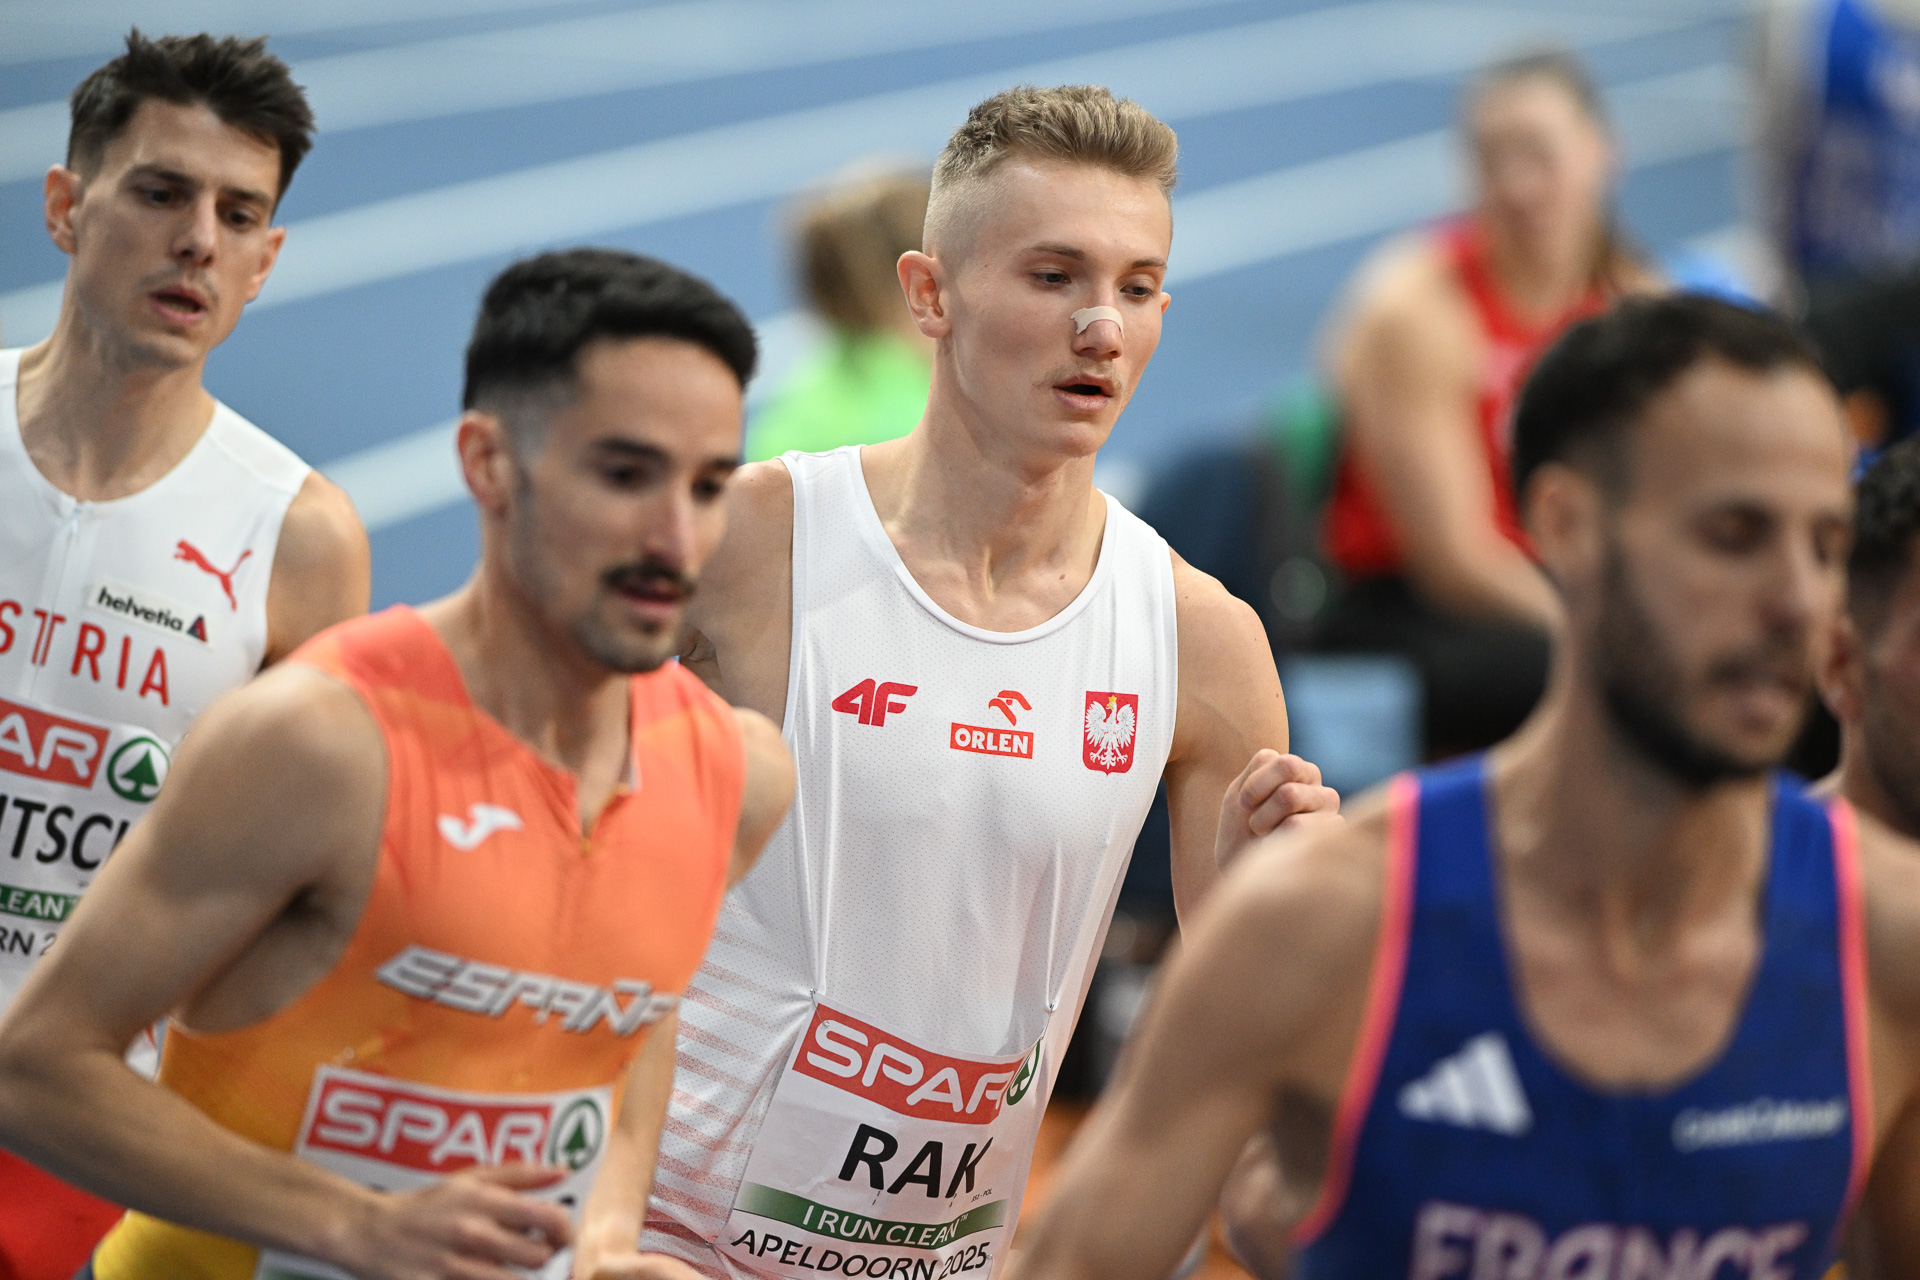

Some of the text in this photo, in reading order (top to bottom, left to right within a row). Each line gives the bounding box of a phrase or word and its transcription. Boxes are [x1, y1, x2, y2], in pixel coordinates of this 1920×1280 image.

[97, 586, 184, 632] helvetia
[832, 678, 918, 727] 4F
[954, 728, 1028, 755] ORLEN
[0, 794, 130, 871] TSC
[0, 887, 65, 919] EAN
[806, 1019, 1015, 1114] SPAR
[316, 1089, 545, 1167] SPAR
[838, 1123, 994, 1199] RAK
[802, 1204, 815, 1226] I
[817, 1209, 883, 1241] RUN
[731, 1229, 990, 1280] APELDOORN 2025
